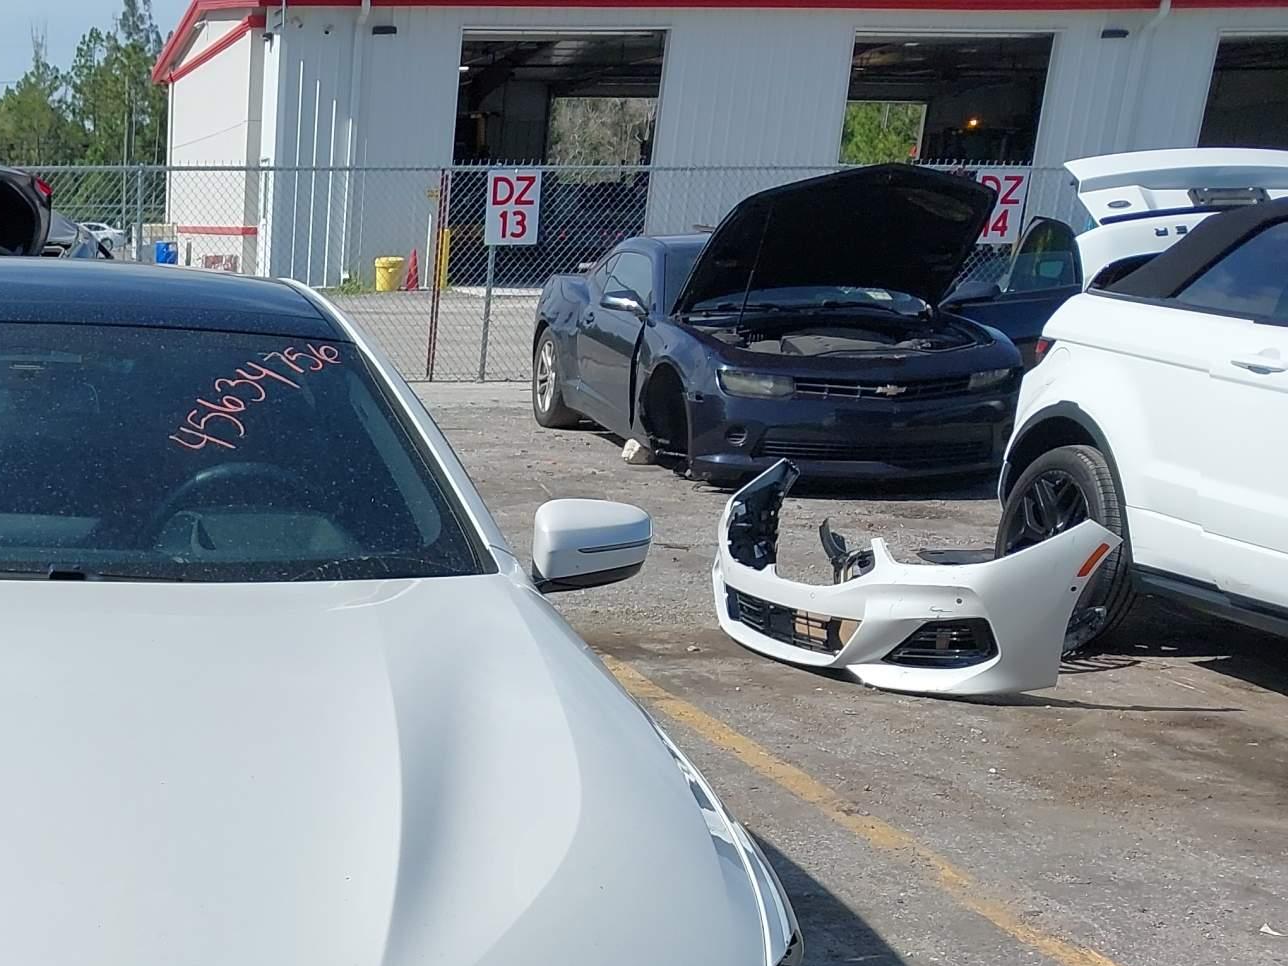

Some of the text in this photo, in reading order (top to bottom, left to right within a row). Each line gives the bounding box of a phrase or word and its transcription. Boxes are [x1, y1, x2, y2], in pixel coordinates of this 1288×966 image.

[492, 175, 536, 206] DZ
[499, 210, 527, 239] 13
[169, 343, 343, 450] 45634756
